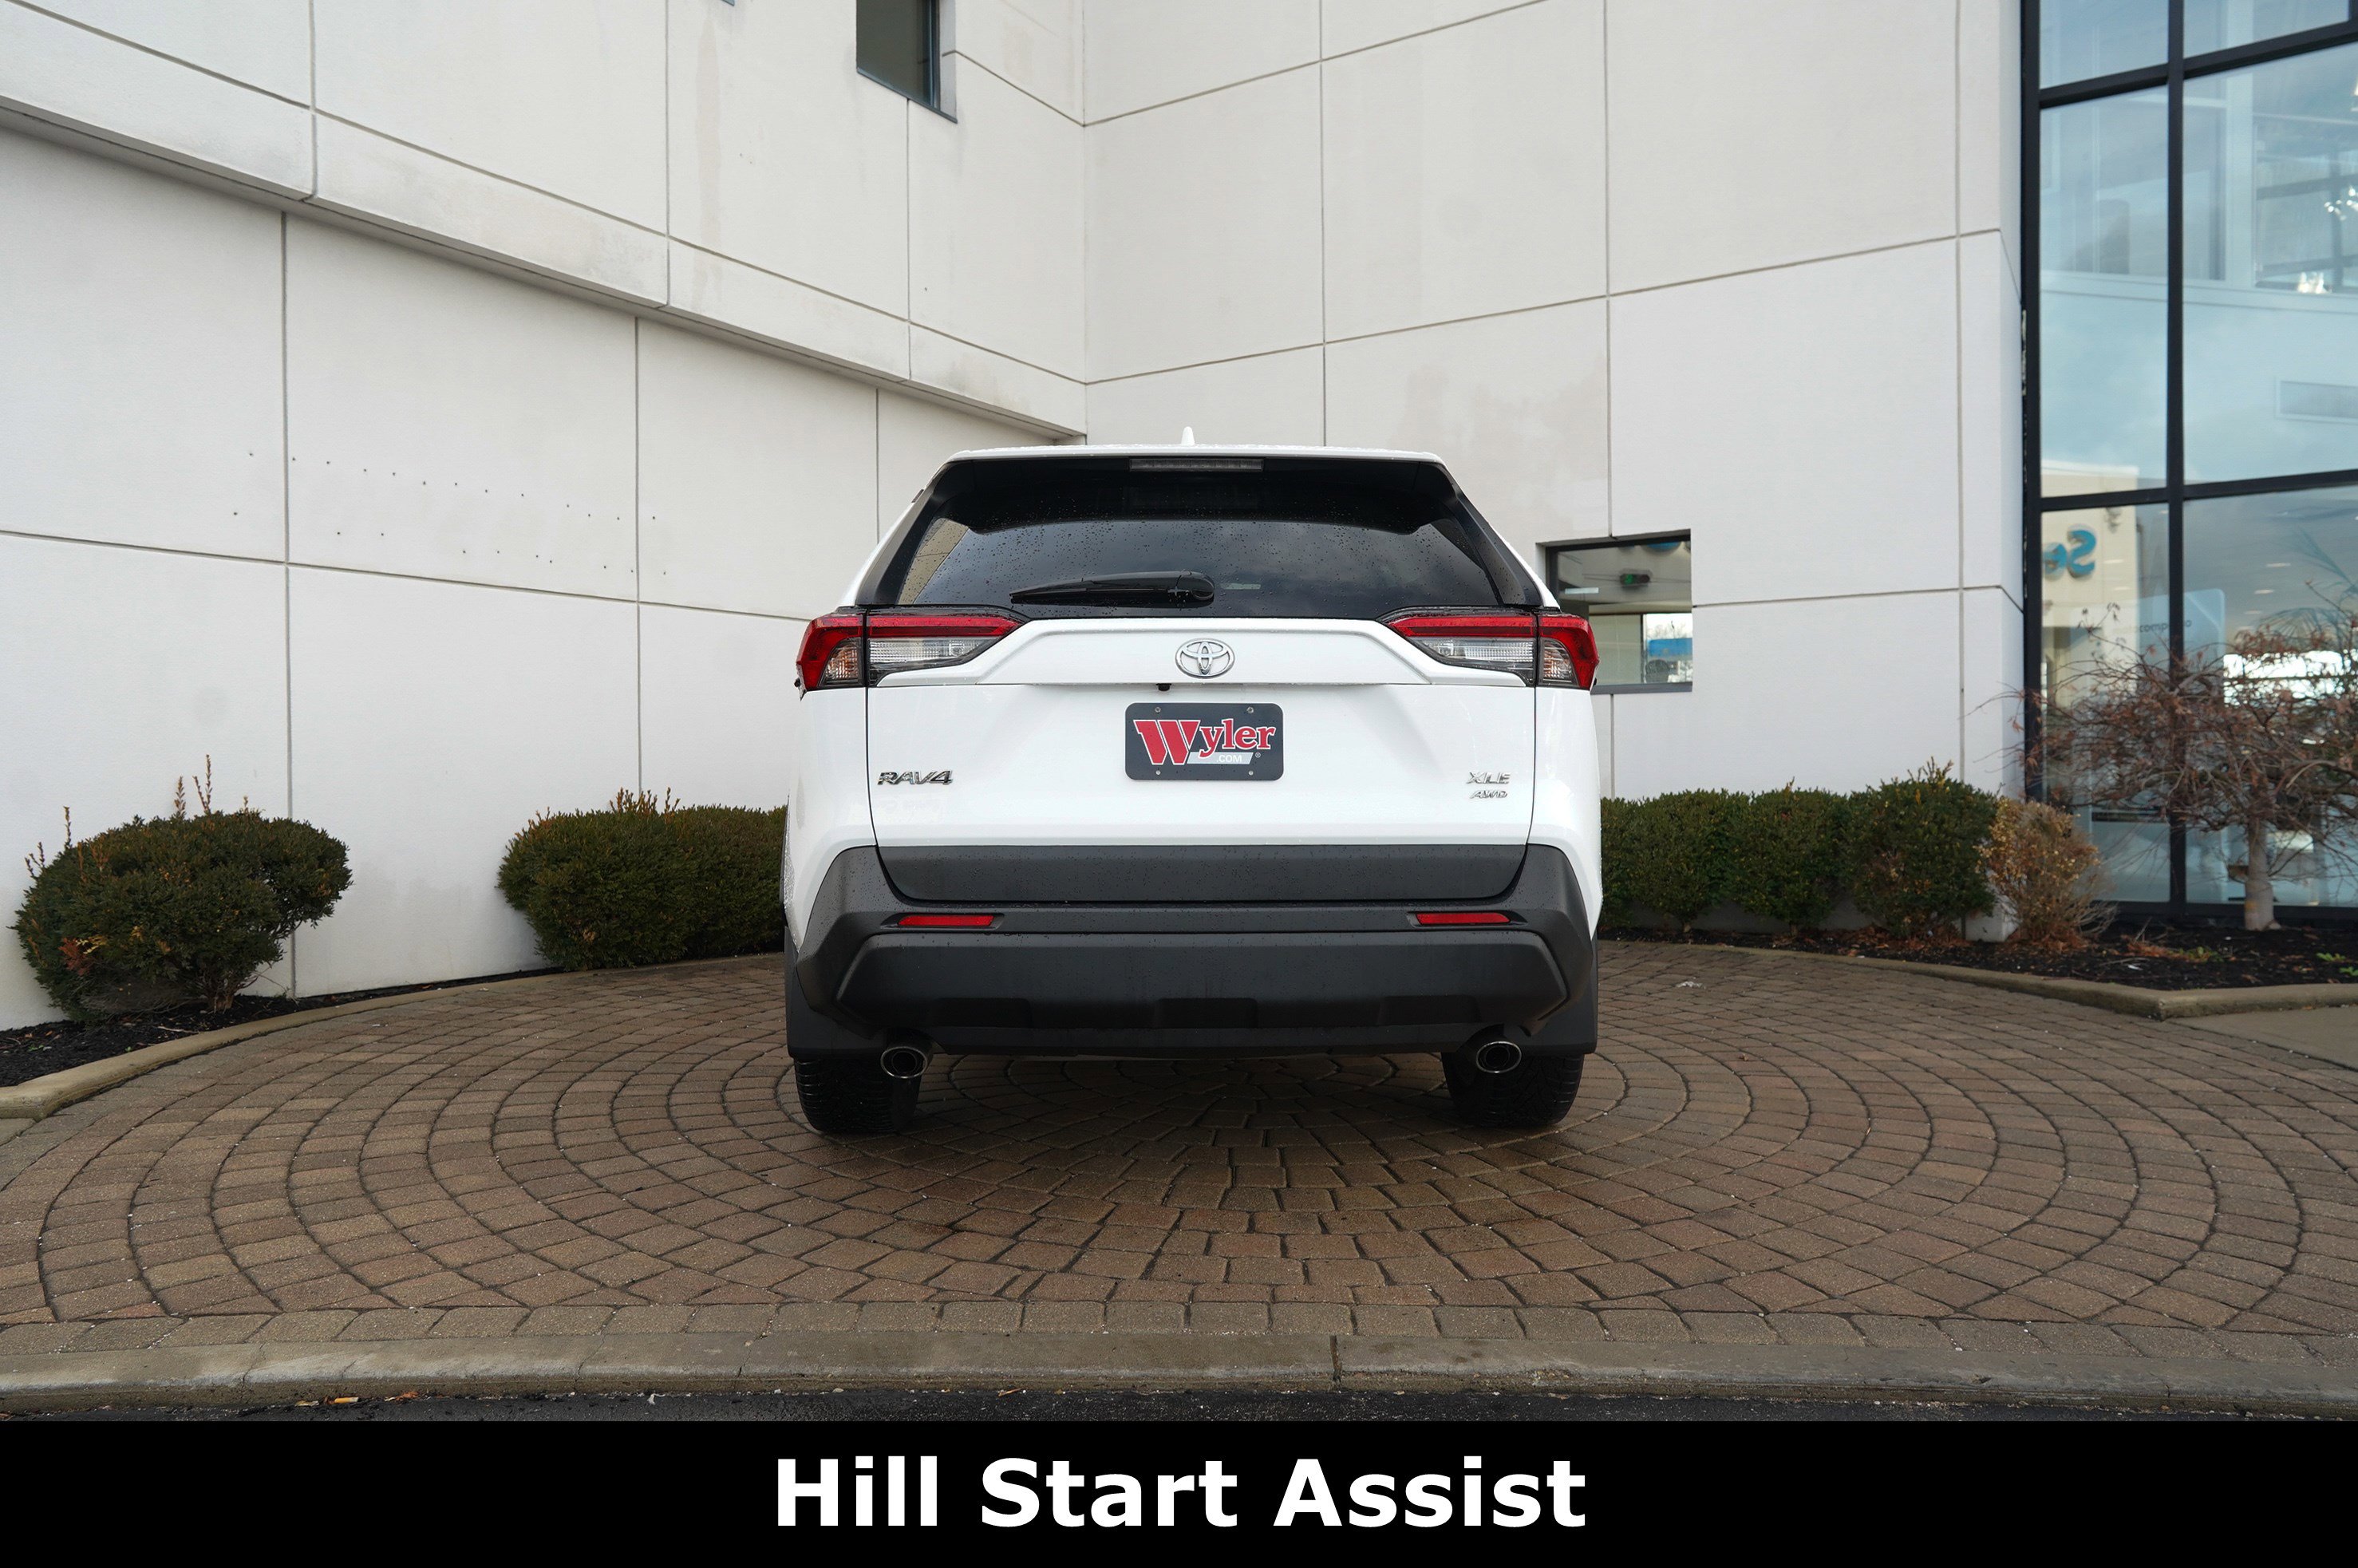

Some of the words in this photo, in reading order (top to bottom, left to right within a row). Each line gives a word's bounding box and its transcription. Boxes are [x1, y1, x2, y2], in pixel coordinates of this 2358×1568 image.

[1133, 718, 1276, 765] Wyler
[1216, 754, 1242, 763] .COM
[877, 770, 953, 785] RAV4
[1466, 772, 1511, 784] XLE
[1469, 790, 1508, 799] AWD
